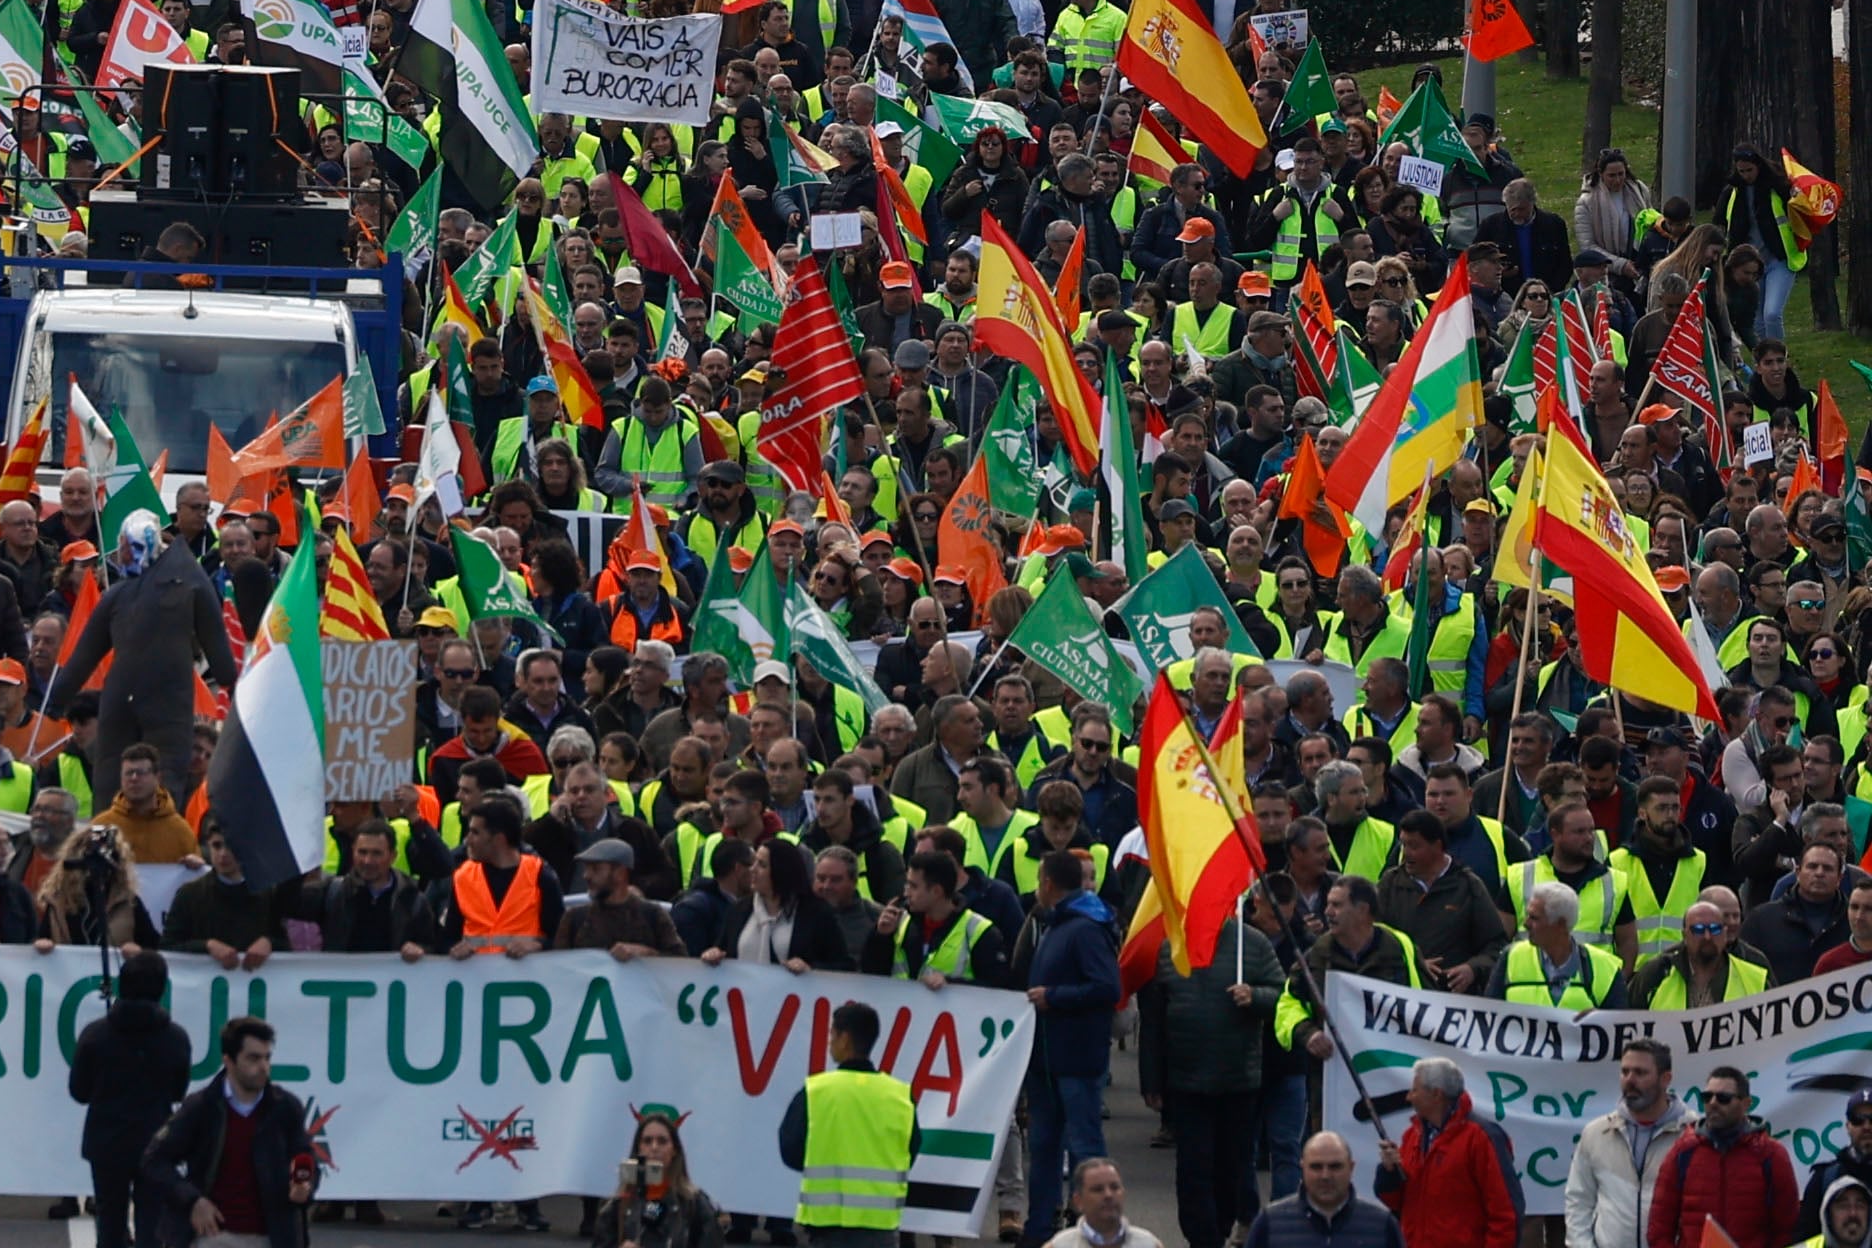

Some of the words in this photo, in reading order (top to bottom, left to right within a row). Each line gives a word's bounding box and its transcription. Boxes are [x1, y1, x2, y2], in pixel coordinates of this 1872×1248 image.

[603, 21, 665, 51] VAIS
[670, 25, 691, 50] A
[605, 48, 704, 78] COMER
[456, 60, 512, 136] UPA-UCE
[560, 68, 699, 108] BUROCRACIA
[1401, 159, 1442, 191] ¡JUSTICIA!
[726, 286, 769, 314] CIUDAD
[1131, 612, 1177, 669] ASAJ
[1030, 641, 1088, 690] CIUDAD
[1054, 641, 1111, 693] ASAJA
[336, 726, 389, 764] ME
[1361, 988, 1565, 1063] VALENCIA
[1576, 1020, 1657, 1064] DEL
[1681, 973, 1872, 1054] VENTOSO
[1487, 1070, 1598, 1120] Por
